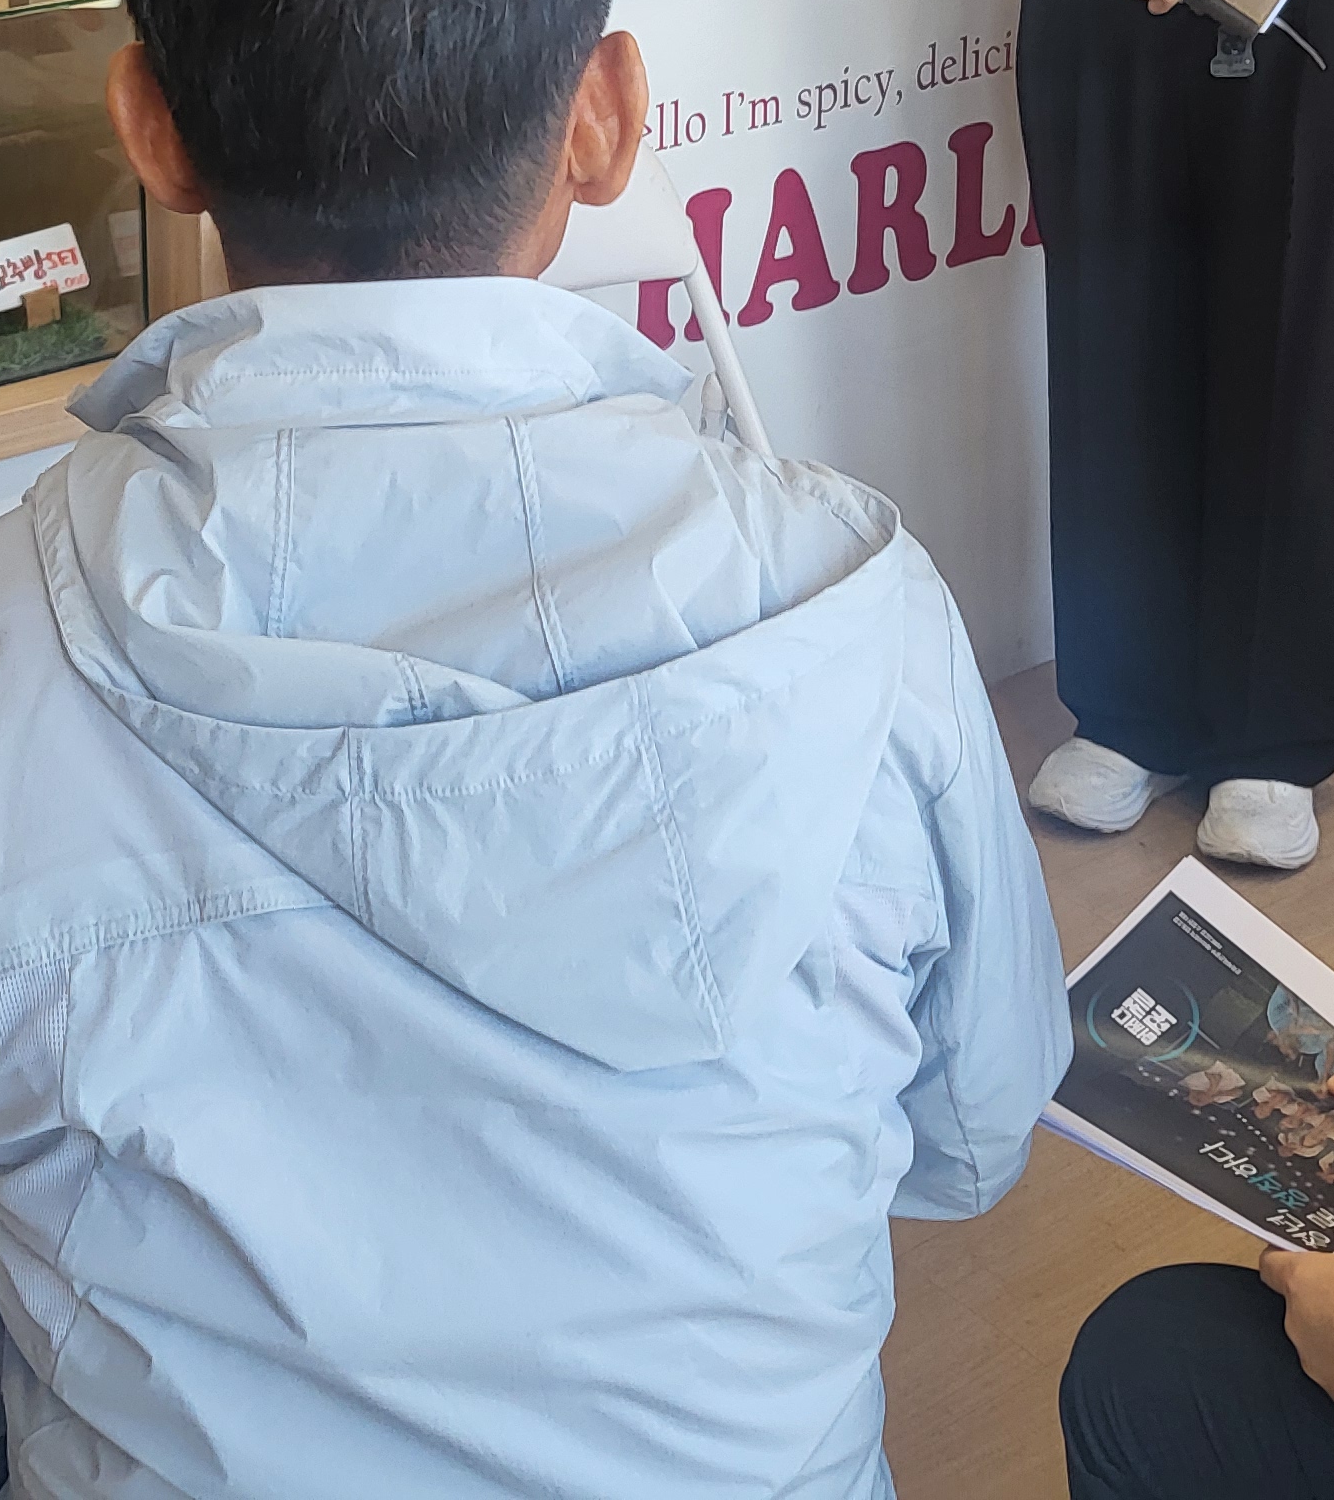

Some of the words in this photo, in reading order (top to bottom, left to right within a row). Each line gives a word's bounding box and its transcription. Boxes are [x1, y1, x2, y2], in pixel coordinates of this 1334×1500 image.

[641, 100, 707, 152] llo
[795, 67, 905, 131] spicy,
[916, 30, 1015, 92] delici
[637, 121, 1043, 351] HARL
[1199, 1141, 1310, 1210] 정착하다
